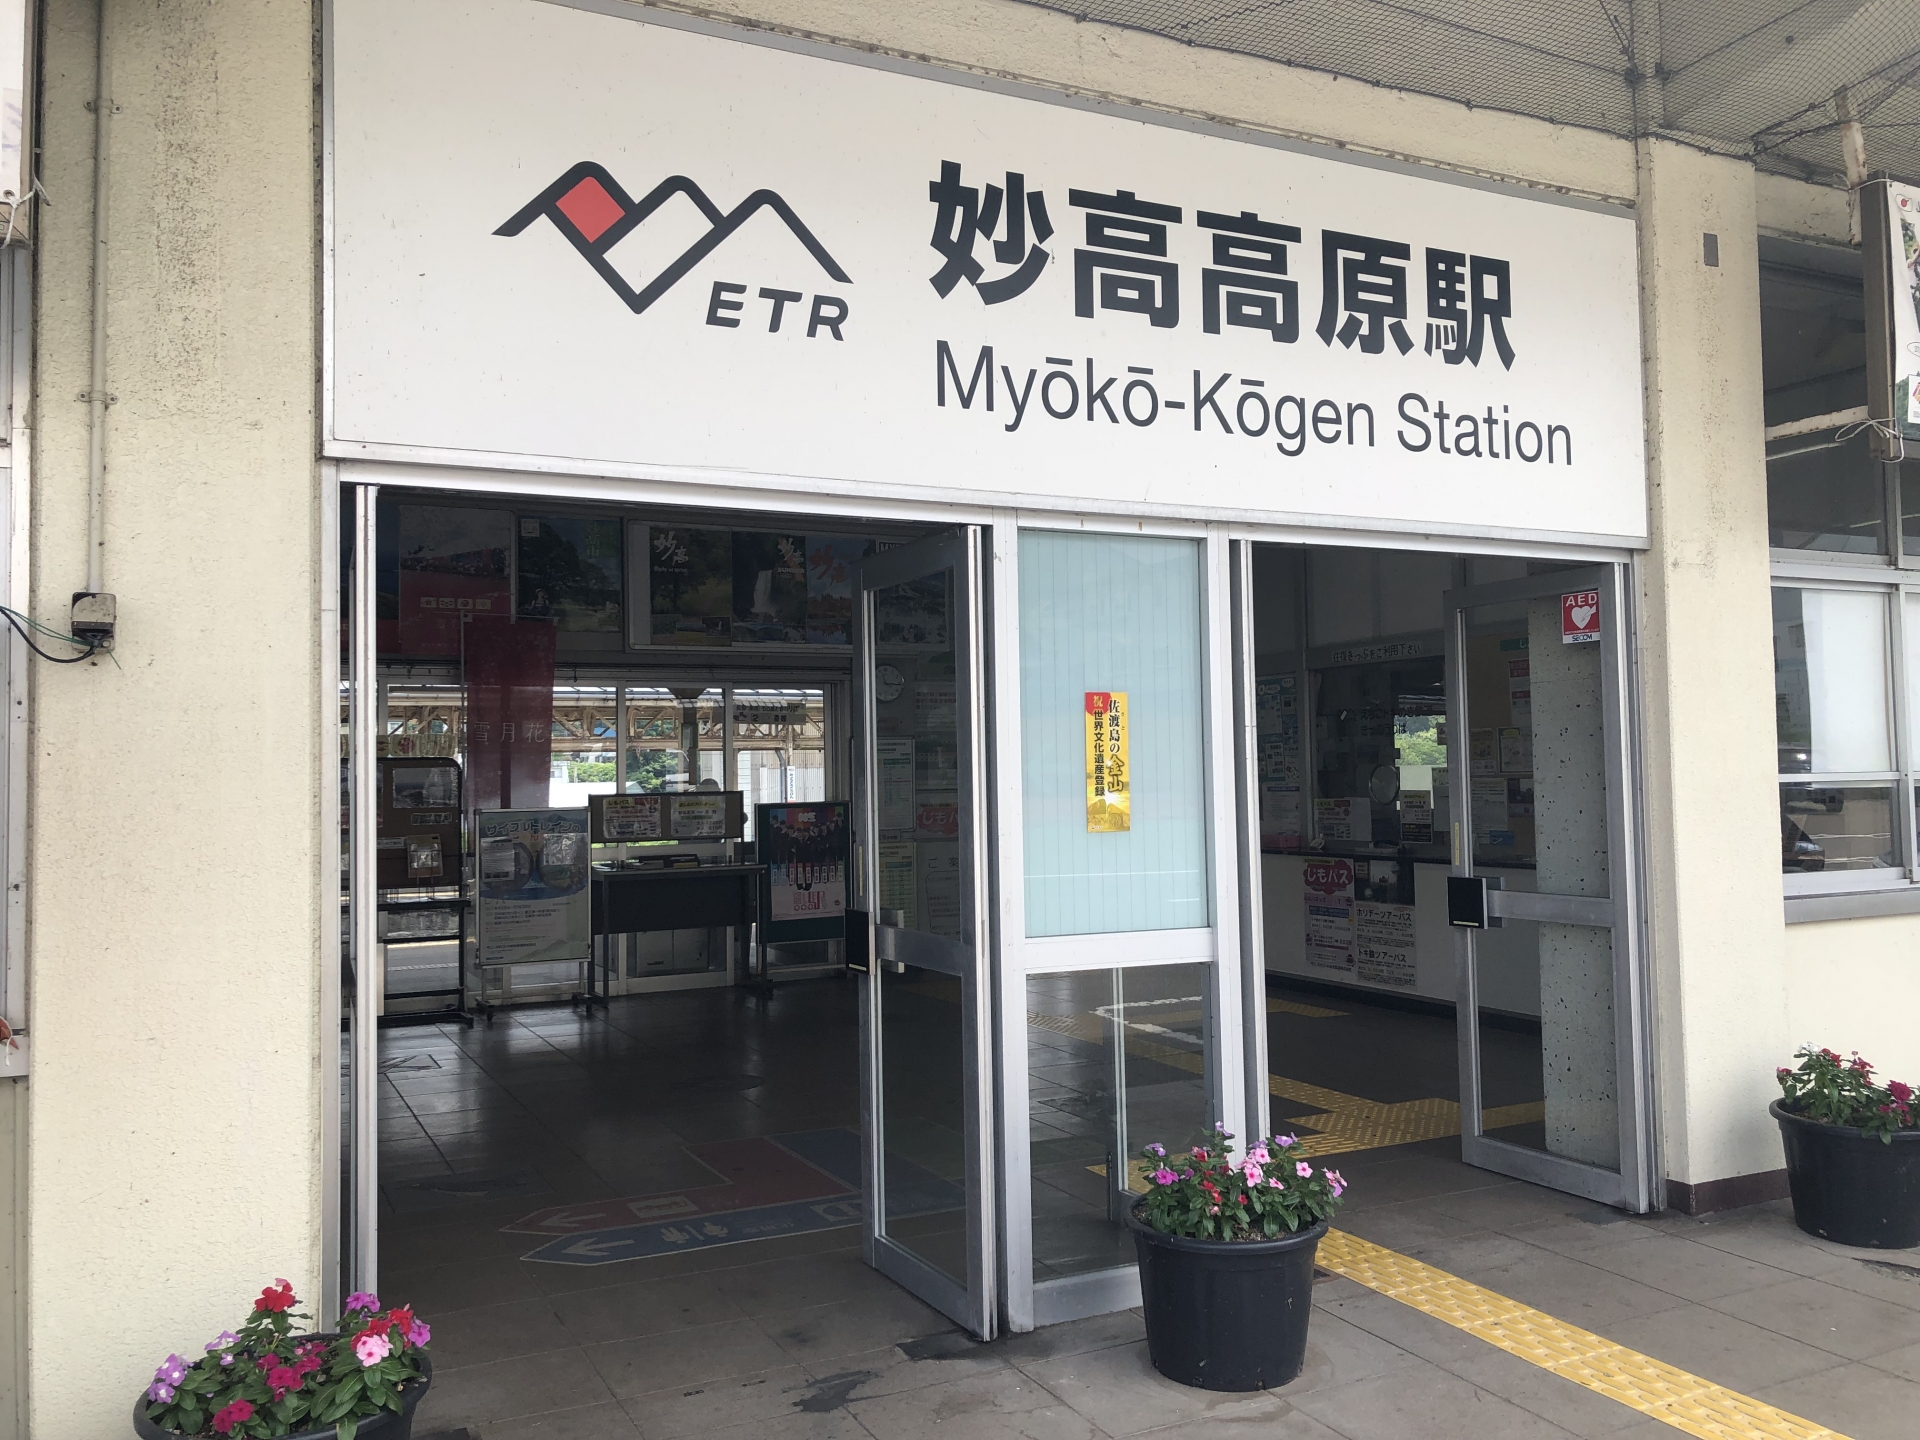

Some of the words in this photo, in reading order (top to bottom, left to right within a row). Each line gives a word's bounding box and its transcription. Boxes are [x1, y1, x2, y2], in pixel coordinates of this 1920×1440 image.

[928, 159, 1516, 371] 妙高高原駅
[706, 280, 849, 342] ETR
[936, 339, 1375, 457] Myōkō-Kōgen
[1398, 392, 1573, 466] Station
[653, 530, 690, 566] 妙高
[1565, 593, 1598, 607] AED
[1572, 634, 1592, 642] SECOM
[1093, 694, 1104, 708] 祝
[474, 721, 546, 743] 雪月花
[1106, 699, 1125, 793] 佐渡島の金山
[1093, 709, 1106, 797] 世界文化遺産登録
[1307, 867, 1350, 885] じもパス
